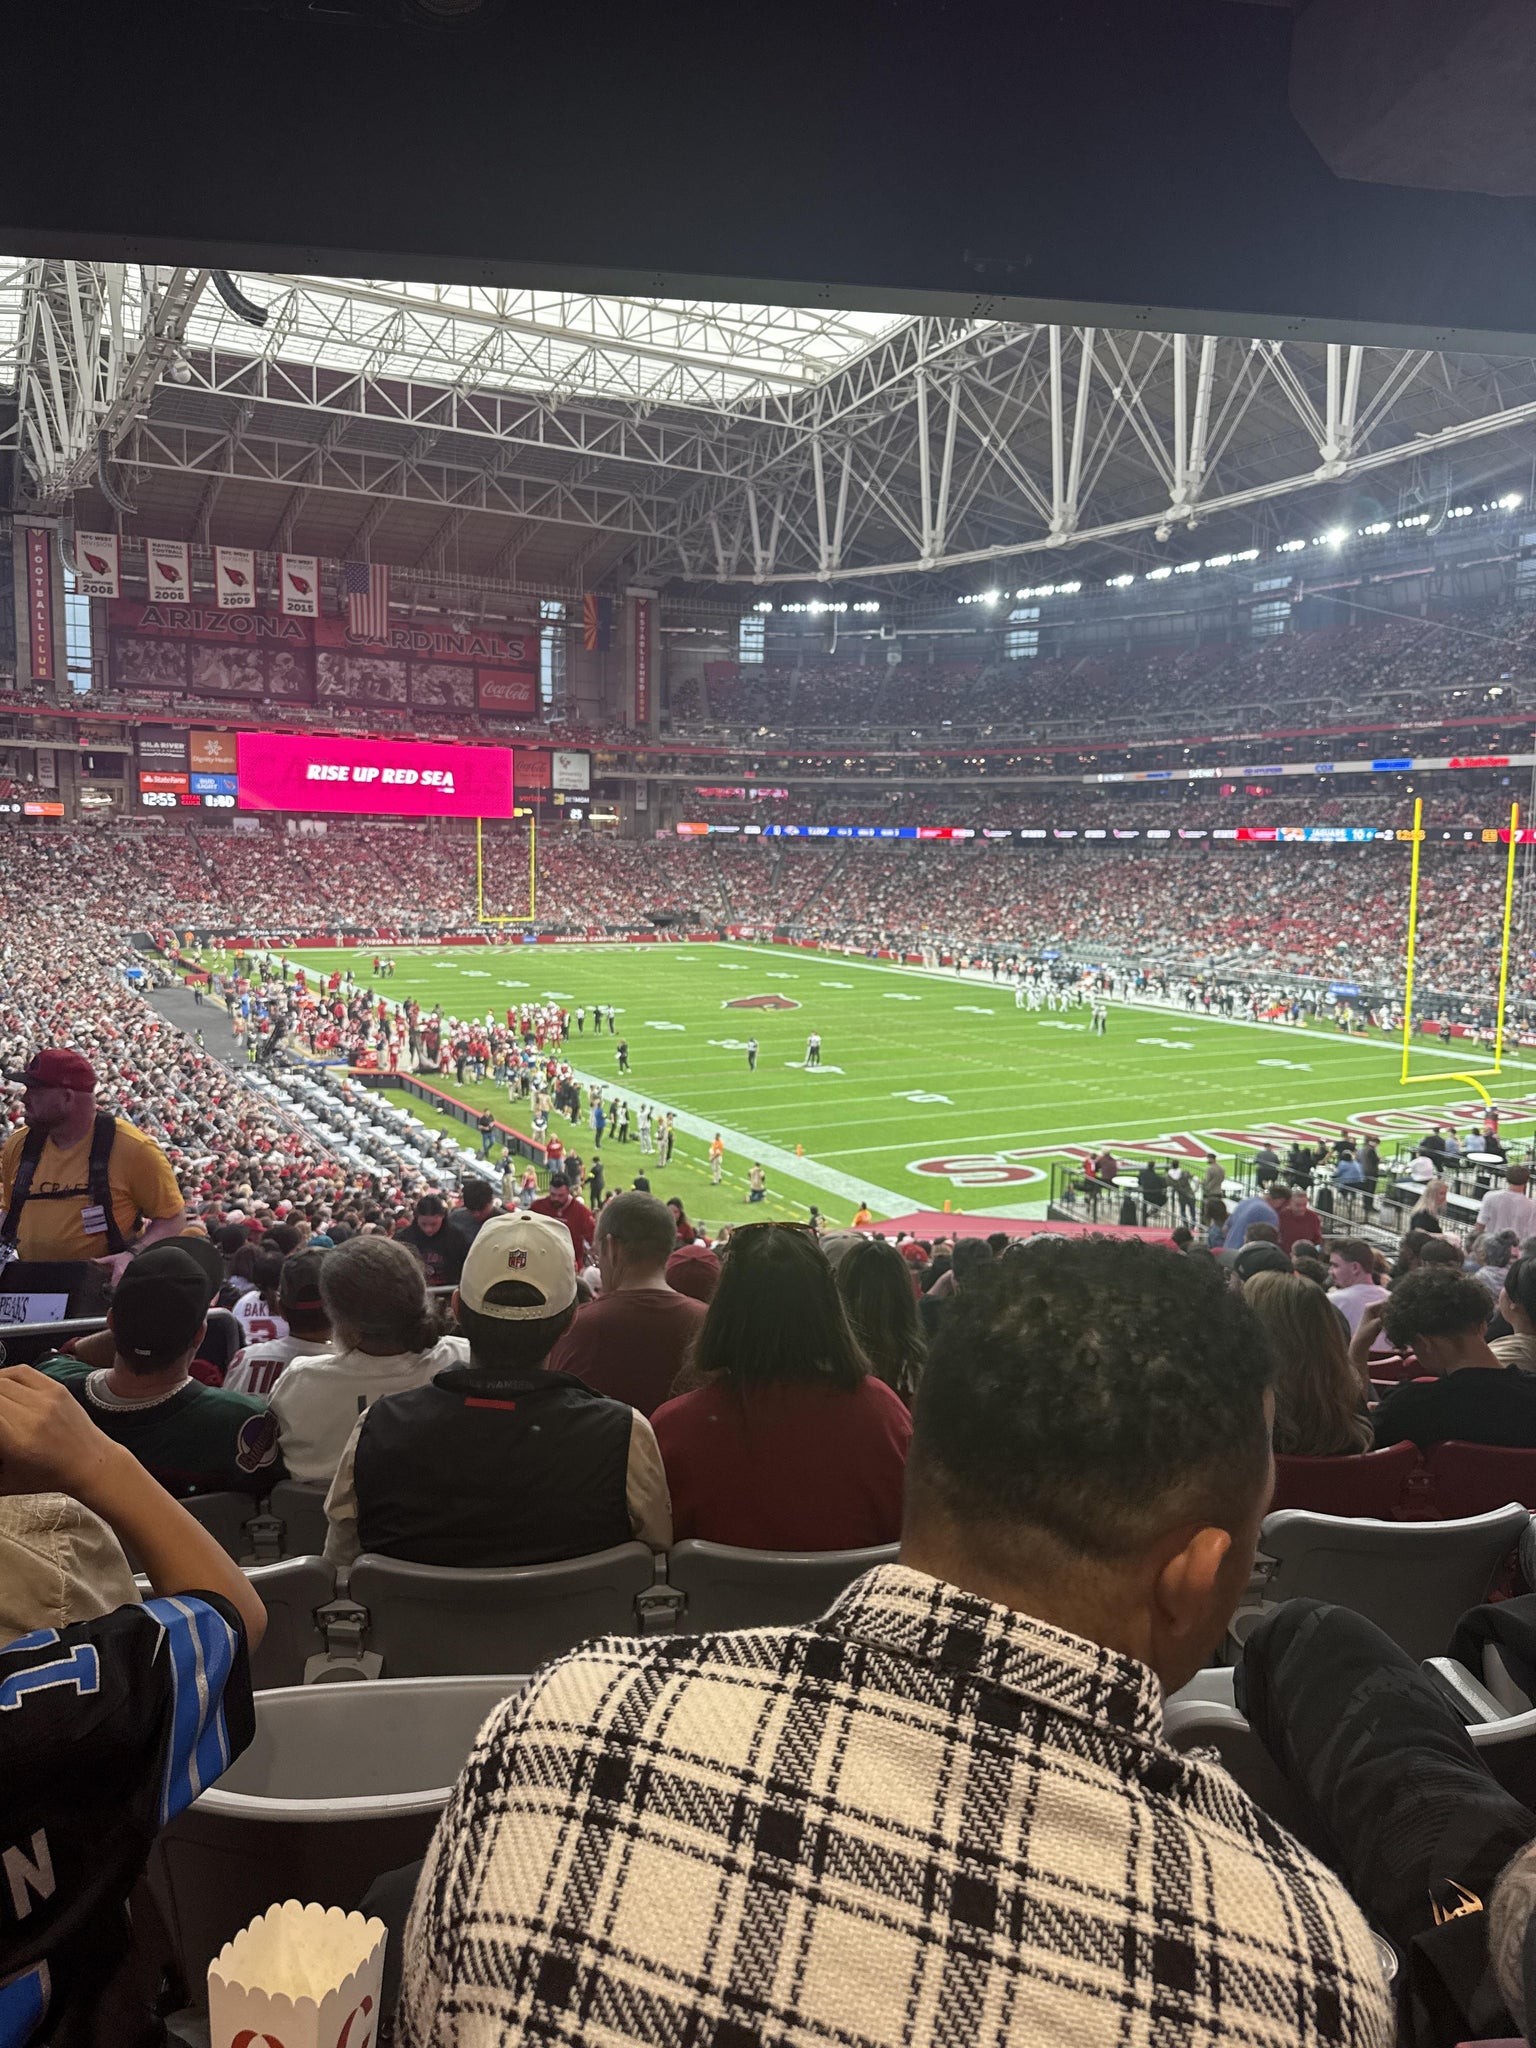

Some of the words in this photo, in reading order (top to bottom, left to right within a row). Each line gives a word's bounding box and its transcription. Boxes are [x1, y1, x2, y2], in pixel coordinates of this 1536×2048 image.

[35, 544, 45, 631] FOOTBALL
[83, 585, 114, 594] 2008
[155, 592, 184, 600] 2008
[223, 597, 250, 606] 2009
[287, 602, 314, 612] 2015
[139, 606, 305, 640] ARIZONA
[38, 634, 46, 676] CLUB
[307, 764, 350, 781] RISE
[352, 766, 380, 782] UP
[381, 768, 419, 784] RED
[420, 770, 454, 786] SEA
[509, 1257, 526, 1269] NFL
